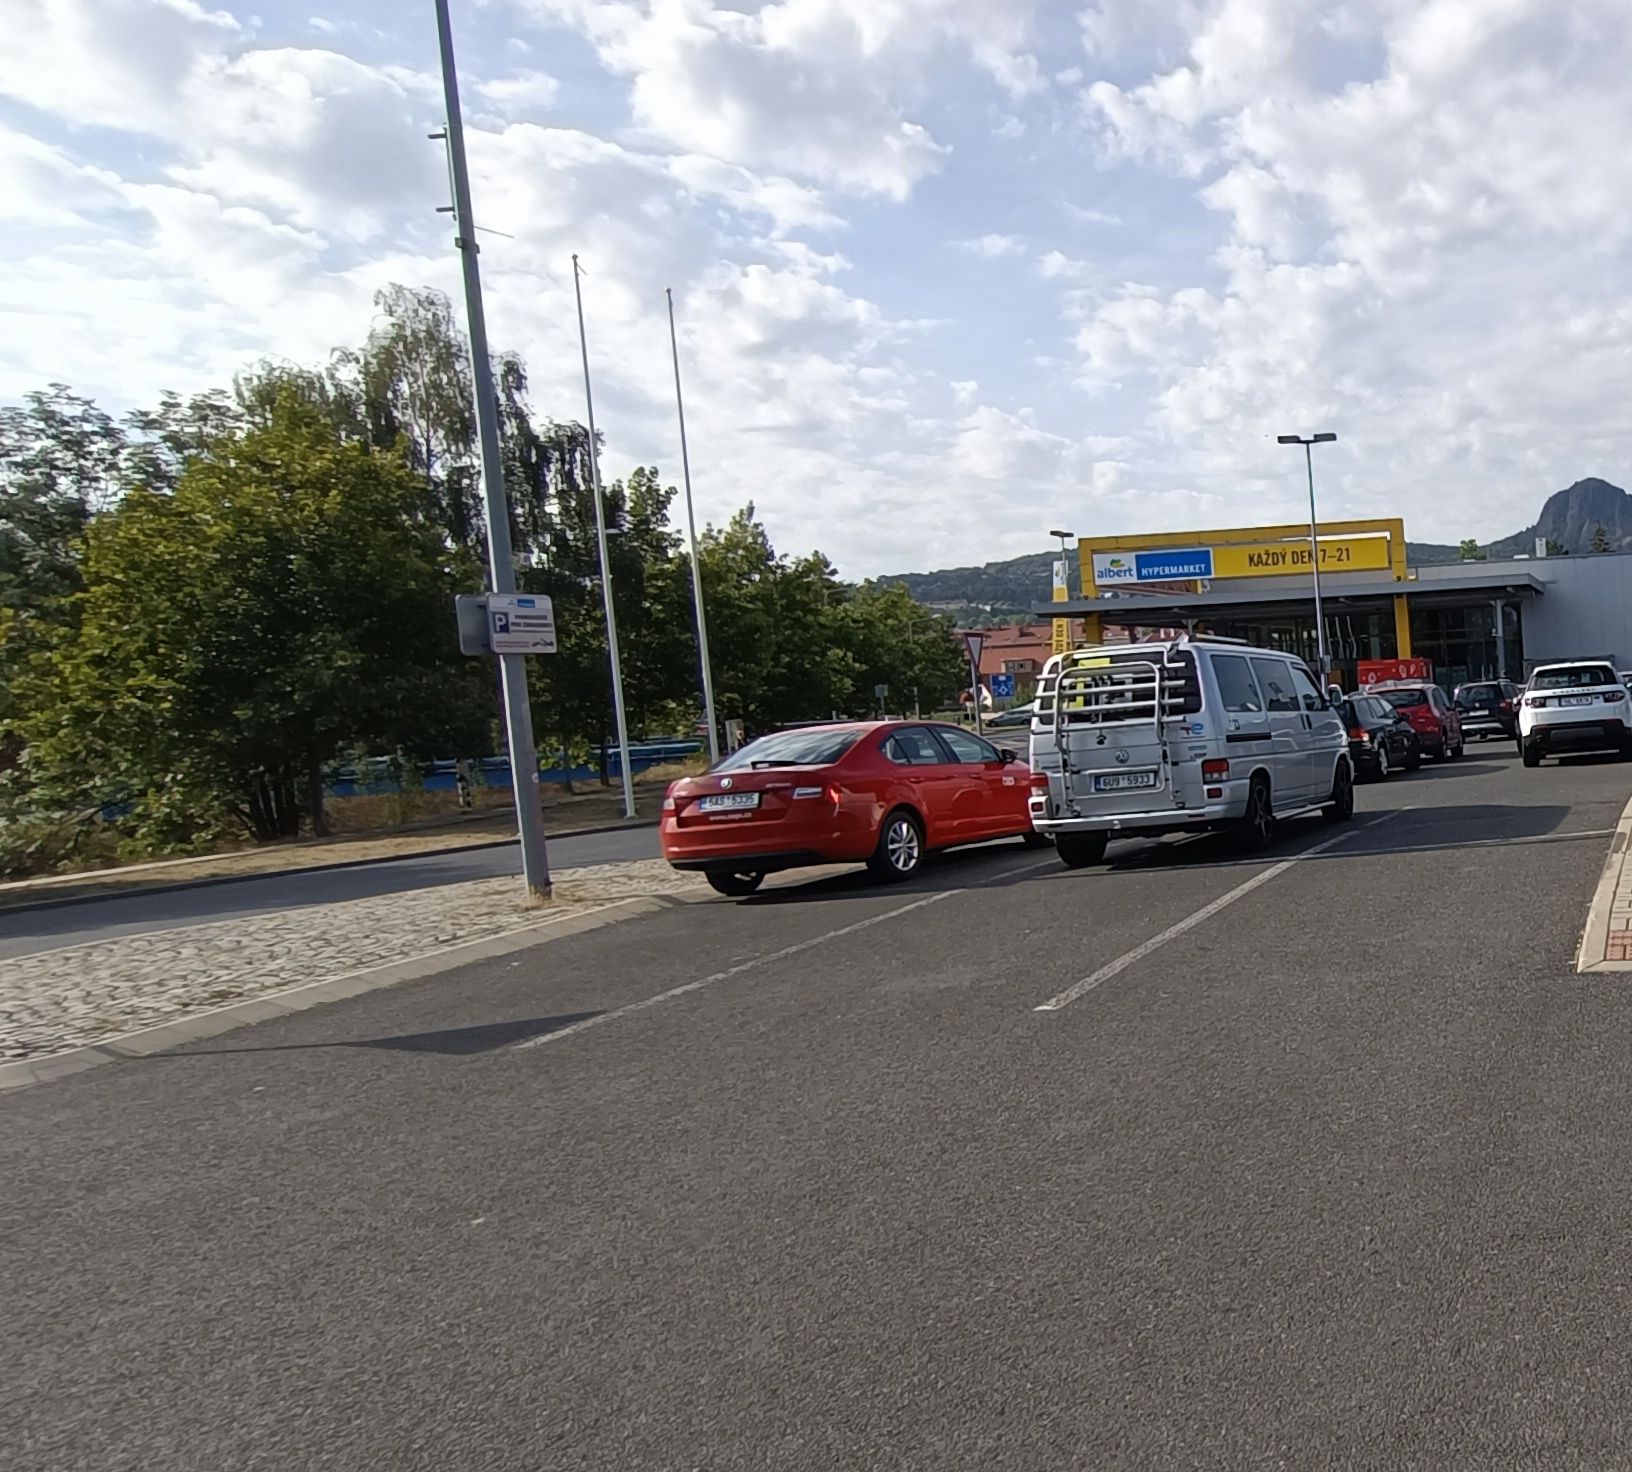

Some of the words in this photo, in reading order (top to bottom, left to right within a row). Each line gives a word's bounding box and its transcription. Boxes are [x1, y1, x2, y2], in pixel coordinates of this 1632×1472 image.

[1248, 548, 1287, 568] KAŽDÝ
[1097, 566, 1134, 579] albert
[1141, 564, 1206, 577] HYPERMARKET
[494, 614, 507, 632] P
[1102, 776, 1120, 787] 6U9
[1127, 774, 1150, 785] 5933
